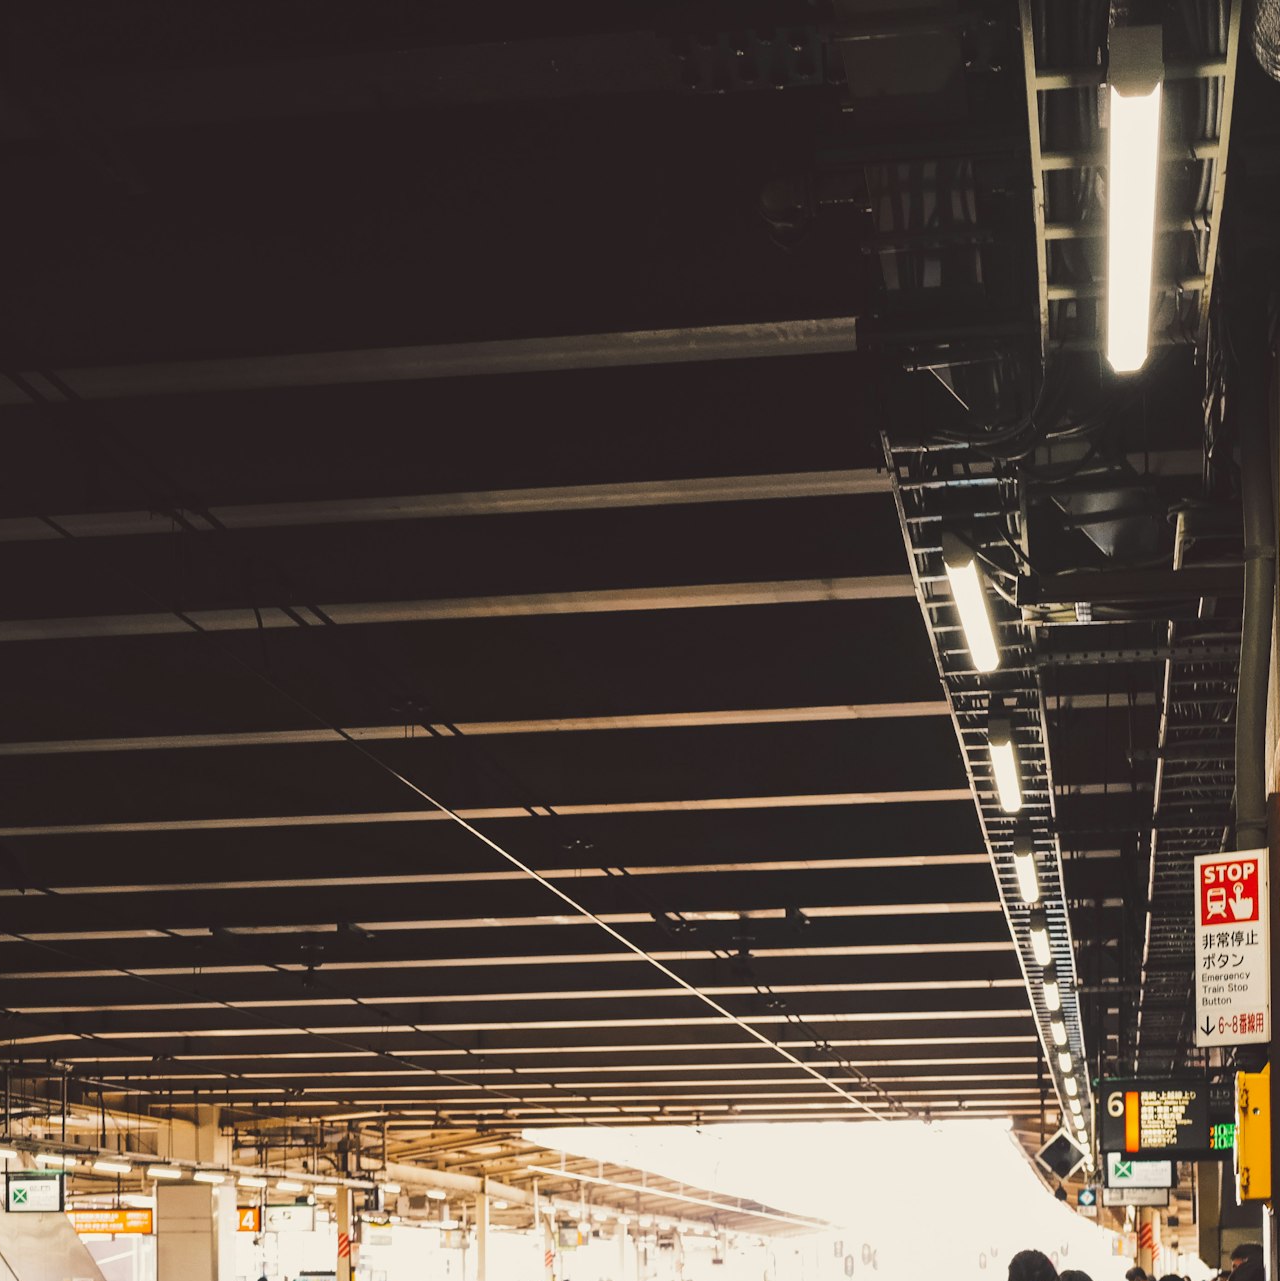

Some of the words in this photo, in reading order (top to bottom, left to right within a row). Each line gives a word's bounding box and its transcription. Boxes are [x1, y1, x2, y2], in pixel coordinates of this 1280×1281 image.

[1203, 862, 1255, 885] STOP
[1202, 930, 1259, 950] 非常停止
[1202, 953, 1244, 970] ボタン
[1202, 971, 1251, 983] Emergency
[1202, 984, 1225, 995] Train
[1228, 983, 1249, 994] Stop
[1202, 997, 1232, 1007] Button
[1107, 1091, 1124, 1117] 6
[242, 1212, 255, 1229] 4
